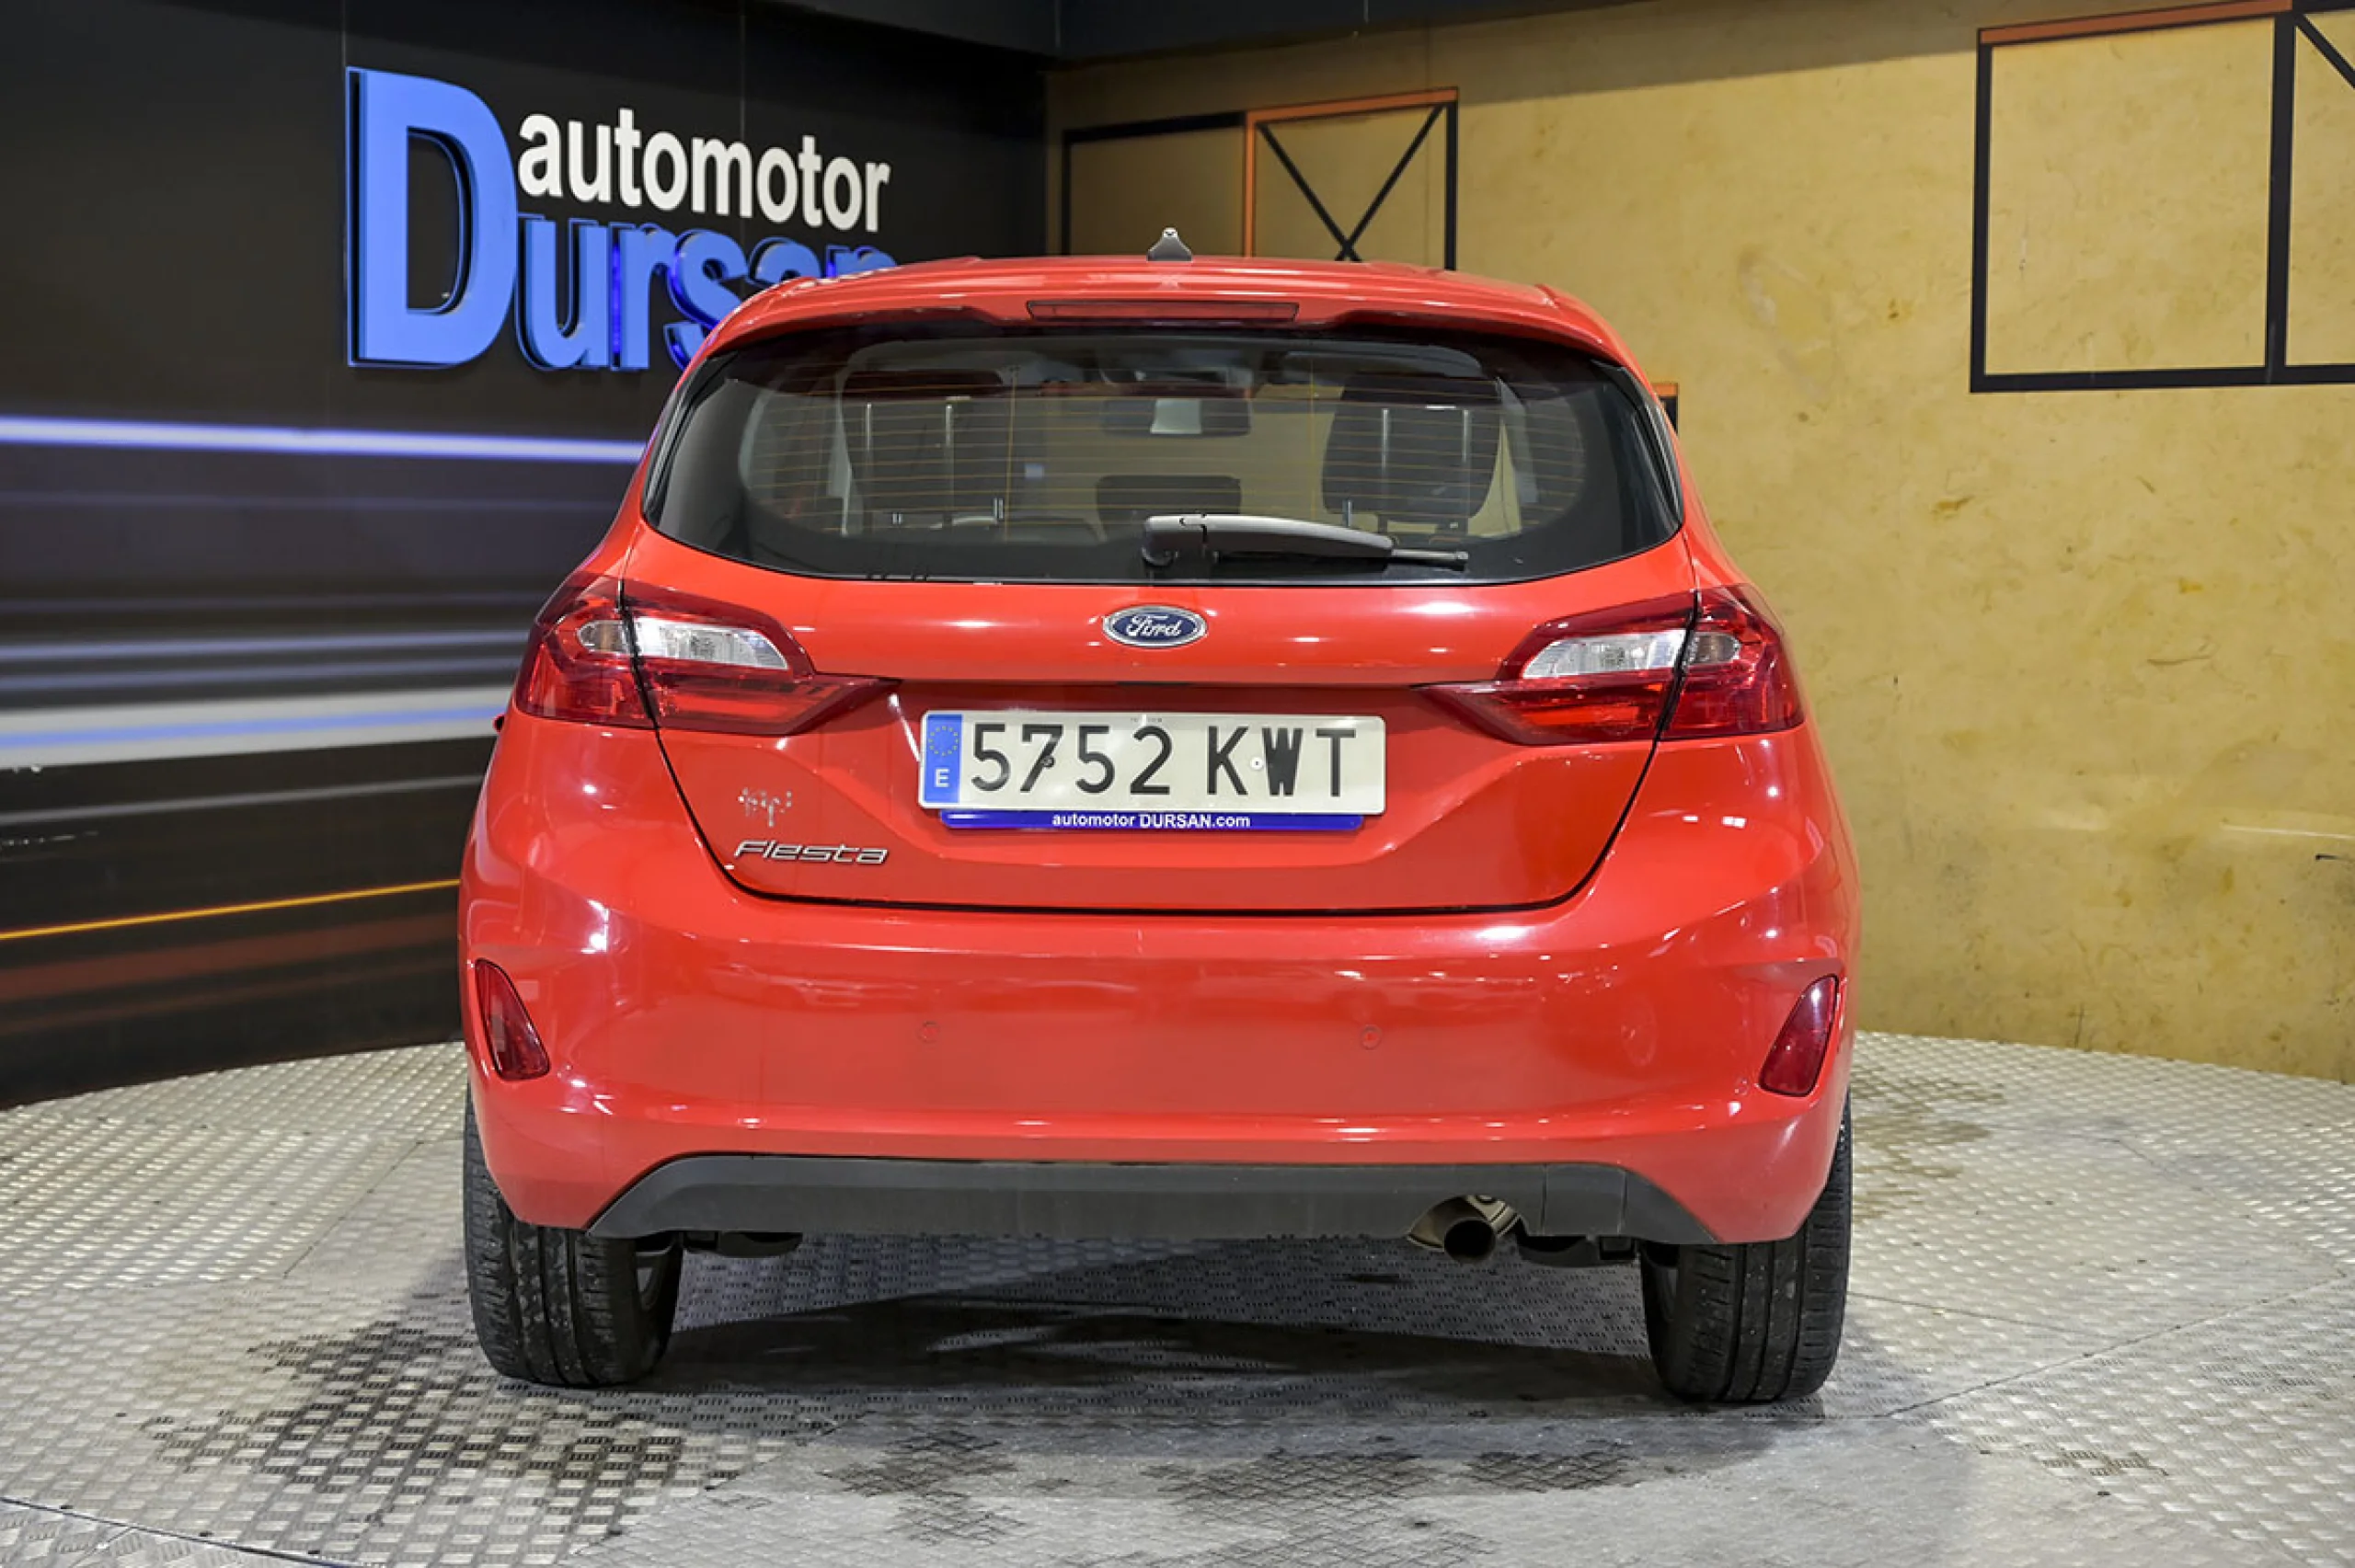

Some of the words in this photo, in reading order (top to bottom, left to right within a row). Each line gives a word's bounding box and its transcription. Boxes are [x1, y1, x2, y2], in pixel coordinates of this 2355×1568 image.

[518, 108, 890, 233] automotor
[346, 65, 897, 371] Durs
[1126, 614, 1182, 636] Ford
[971, 723, 1173, 795] 5752
[1206, 725, 1357, 797] KWT
[935, 770, 950, 788] E
[1051, 813, 1136, 828] automotor
[1139, 813, 1251, 829] DURSAN.com
[734, 840, 890, 865] Fiesta
